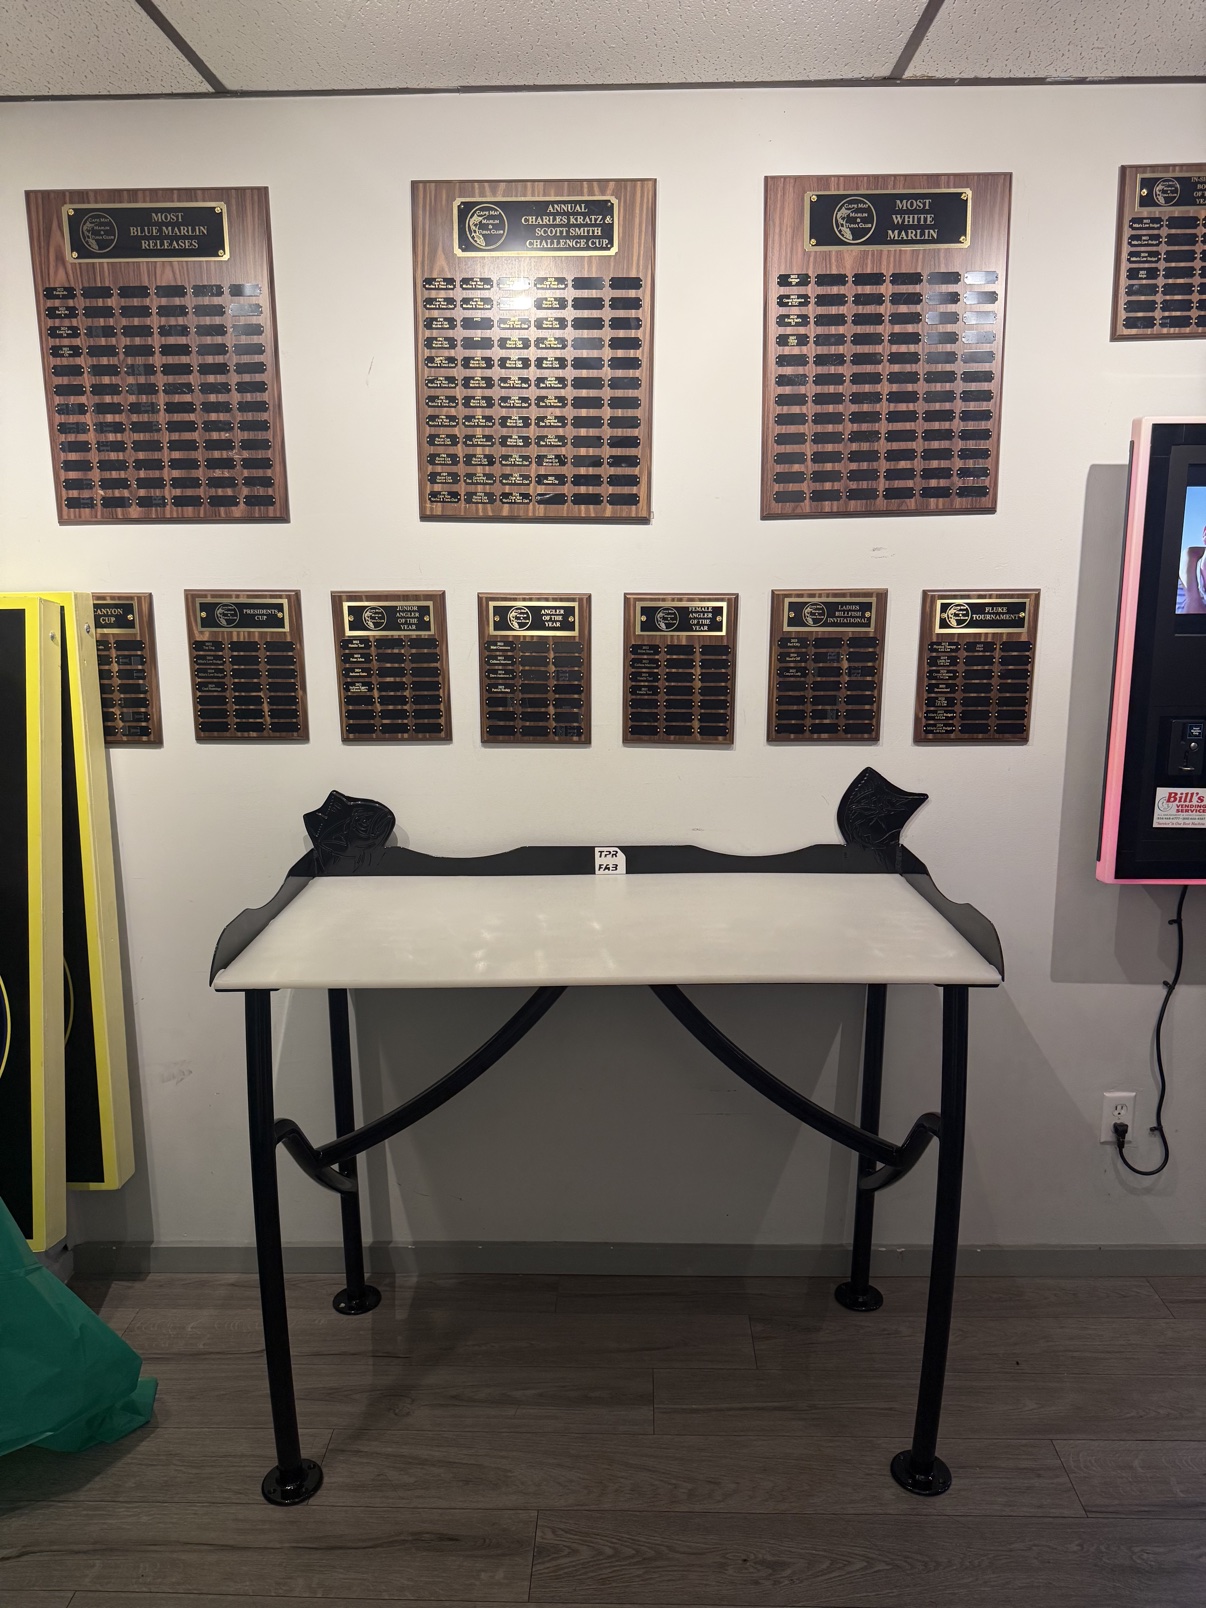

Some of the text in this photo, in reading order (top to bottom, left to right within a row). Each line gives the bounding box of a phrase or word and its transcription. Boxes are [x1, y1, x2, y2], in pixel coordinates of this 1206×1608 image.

[547, 204, 587, 212] ANNUAL
[896, 200, 931, 210] MOST
[152, 213, 183, 222] MOST
[522, 216, 567, 225] CHARLES
[892, 215, 934, 225] WHITE
[130, 226, 207, 236] BLUE MARLIN
[536, 228, 602, 236] SCOTT SMITH
[887, 229, 938, 240] MARLIN
[142, 240, 198, 249] RELEASES
[526, 239, 610, 248] CHALLENGE CUP.
[1166, 792, 1204, 803] Bill's
